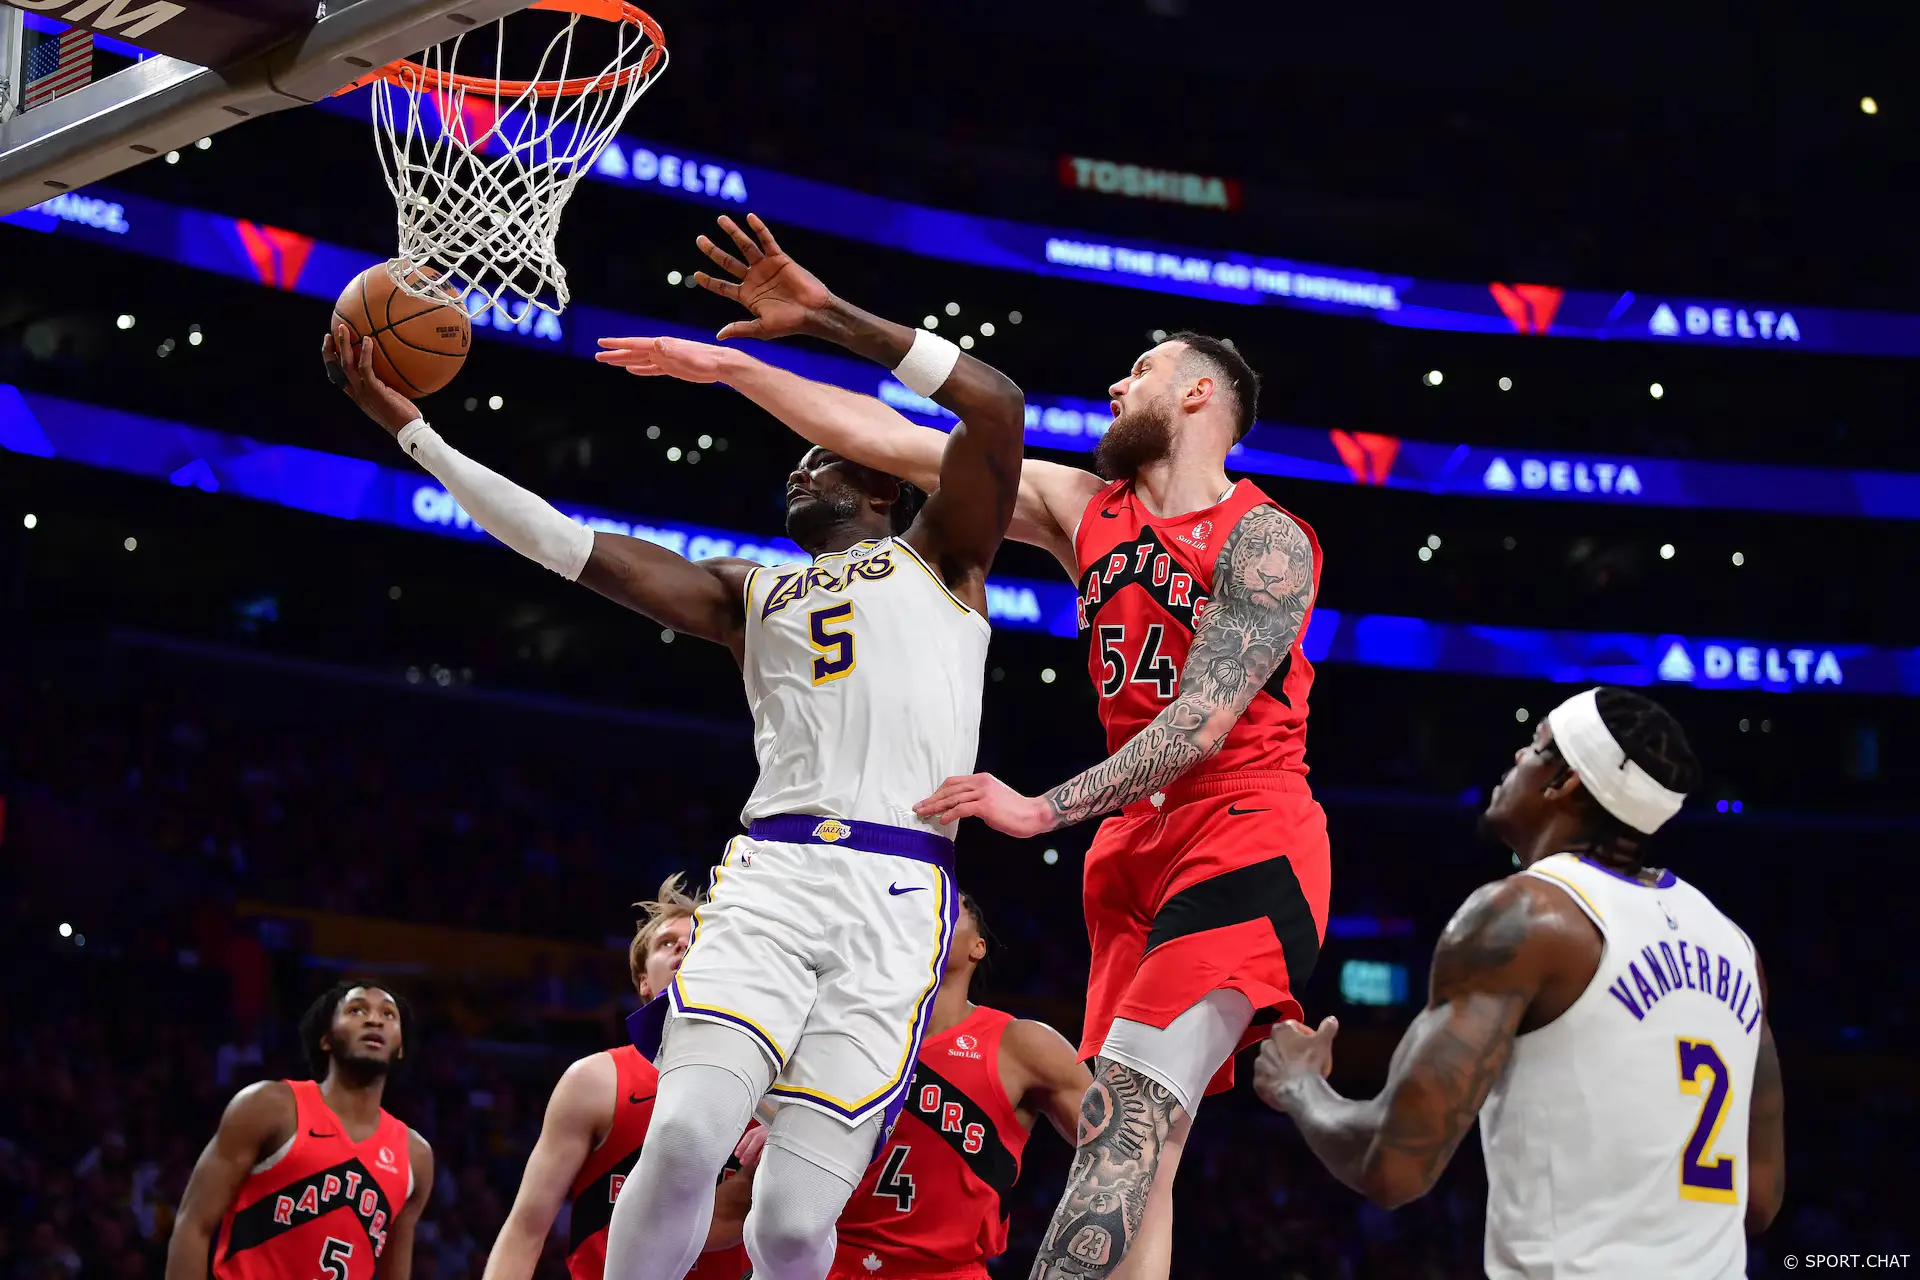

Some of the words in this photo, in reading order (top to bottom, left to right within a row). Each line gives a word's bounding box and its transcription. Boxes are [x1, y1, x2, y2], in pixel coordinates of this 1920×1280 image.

[632, 148, 748, 203] DELTA
[1070, 157, 1228, 210] TOSHIBA
[1114, 247, 1155, 277] THE
[1252, 266, 1291, 296] THE
[457, 287, 562, 342] ELTA
[1685, 306, 1800, 341] DELTA
[1521, 458, 1644, 496] DELTA
[1176, 534, 1192, 545] Sun
[1192, 540, 1207, 550] Life
[1076, 543, 1209, 630] RAPTORS
[808, 600, 856, 687] 5
[1098, 624, 1178, 698] 54
[1703, 645, 1843, 685] DELTA
[1609, 939, 1761, 1035] VANDERBILT
[948, 1049, 964, 1057] Sun
[965, 1051, 982, 1060] Life
[1675, 1035, 1739, 1205] 2
[872, 1145, 916, 1212] 4
[273, 1170, 388, 1258] RAPTORS
[319, 1235, 354, 1280] 5
[1075, 1227, 1107, 1260] 23
